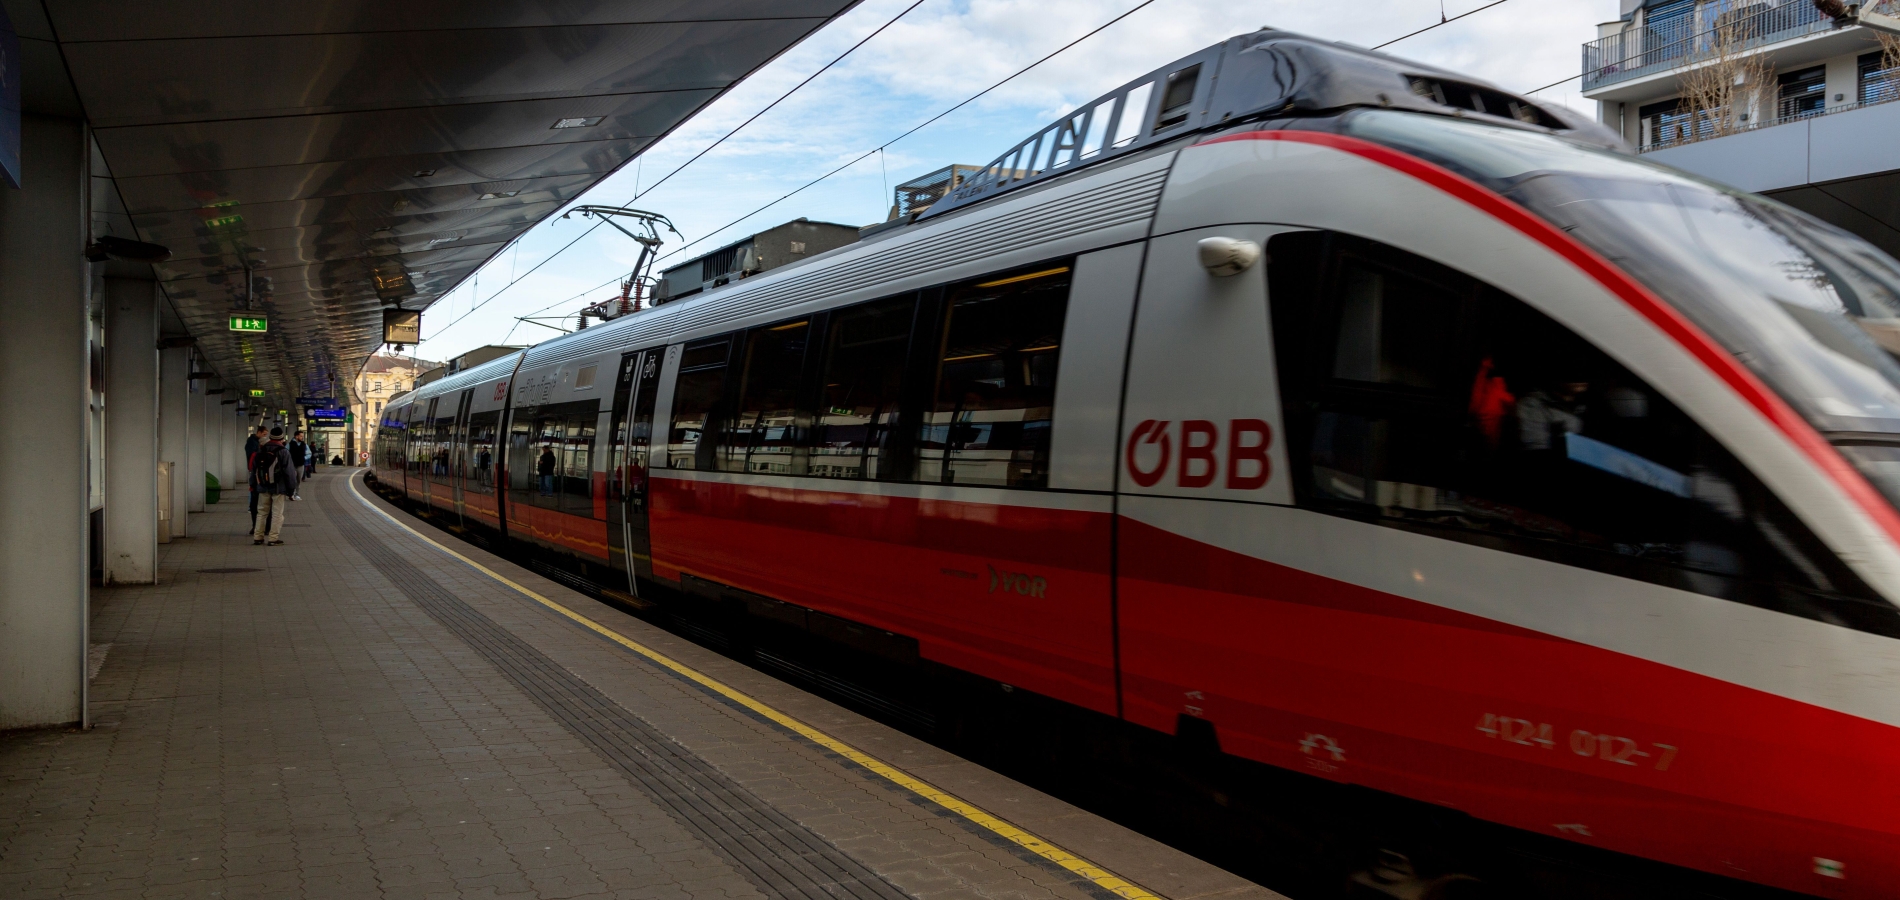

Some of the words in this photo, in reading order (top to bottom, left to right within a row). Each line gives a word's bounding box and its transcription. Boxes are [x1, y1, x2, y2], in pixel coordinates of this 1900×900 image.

[1126, 418, 1273, 490] ÖBB
[1001, 570, 1047, 599] VOR
[1475, 712, 1556, 750] 4124
[1569, 728, 1679, 772] 012-7
